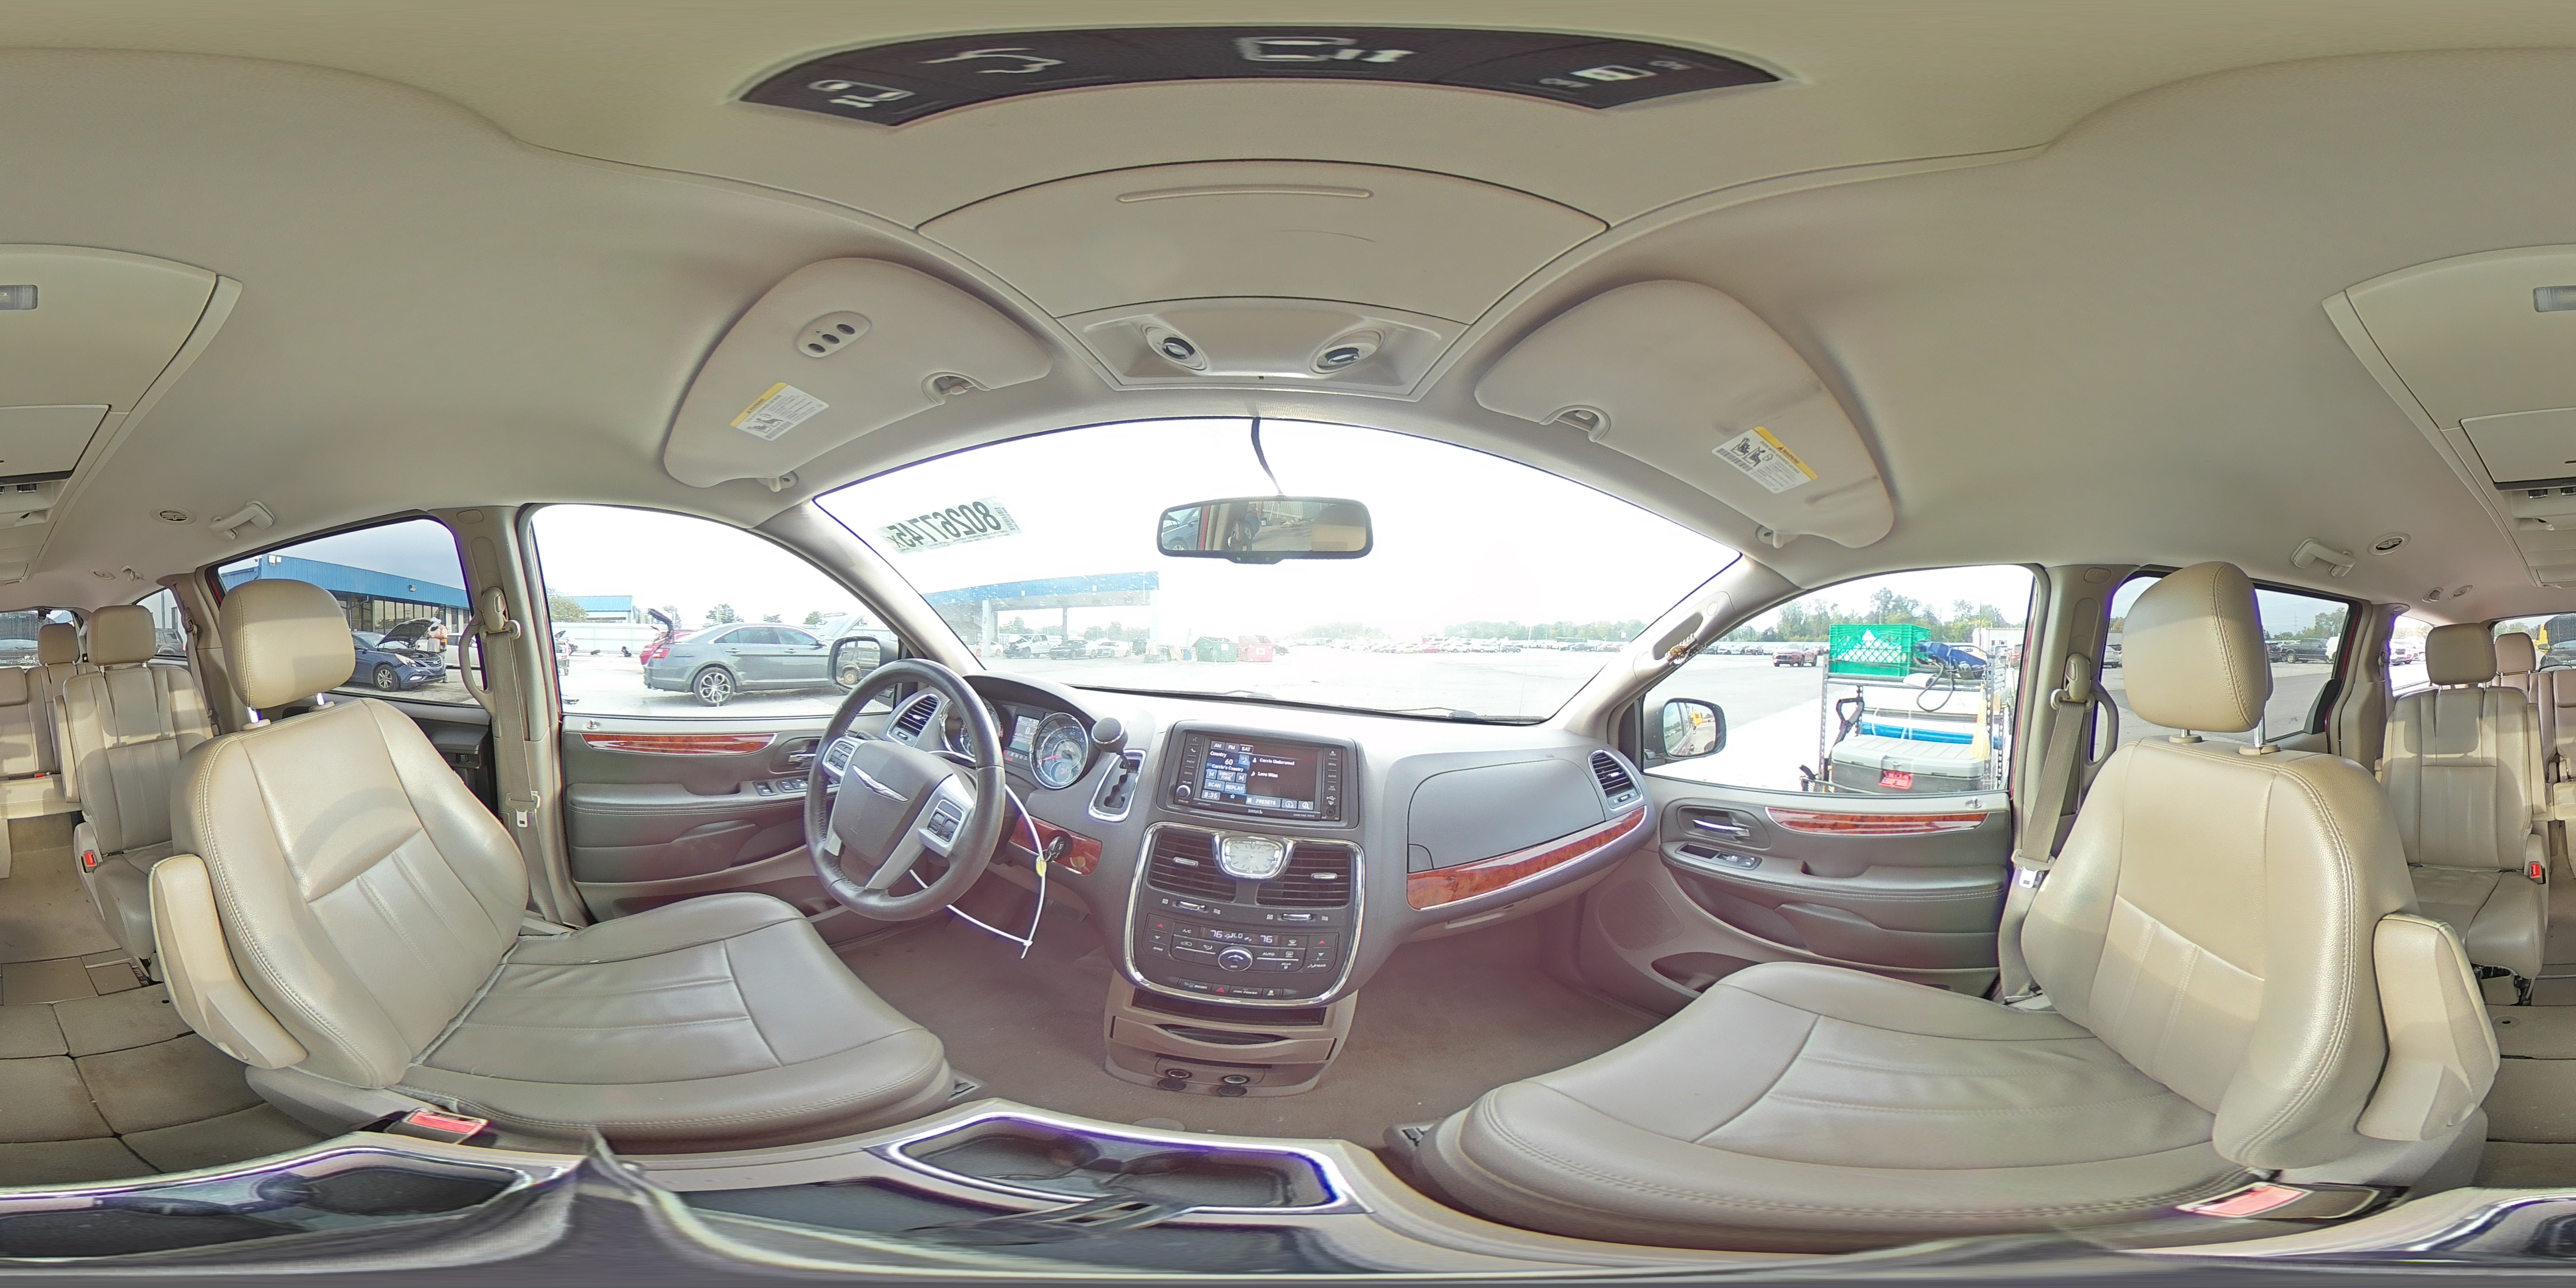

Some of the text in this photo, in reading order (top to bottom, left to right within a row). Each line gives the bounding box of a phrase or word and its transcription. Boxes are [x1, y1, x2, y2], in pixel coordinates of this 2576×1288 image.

[1782, 449, 1800, 464] WARNING
[1210, 930, 1222, 938] 76
[1260, 935, 1273, 943] 76
